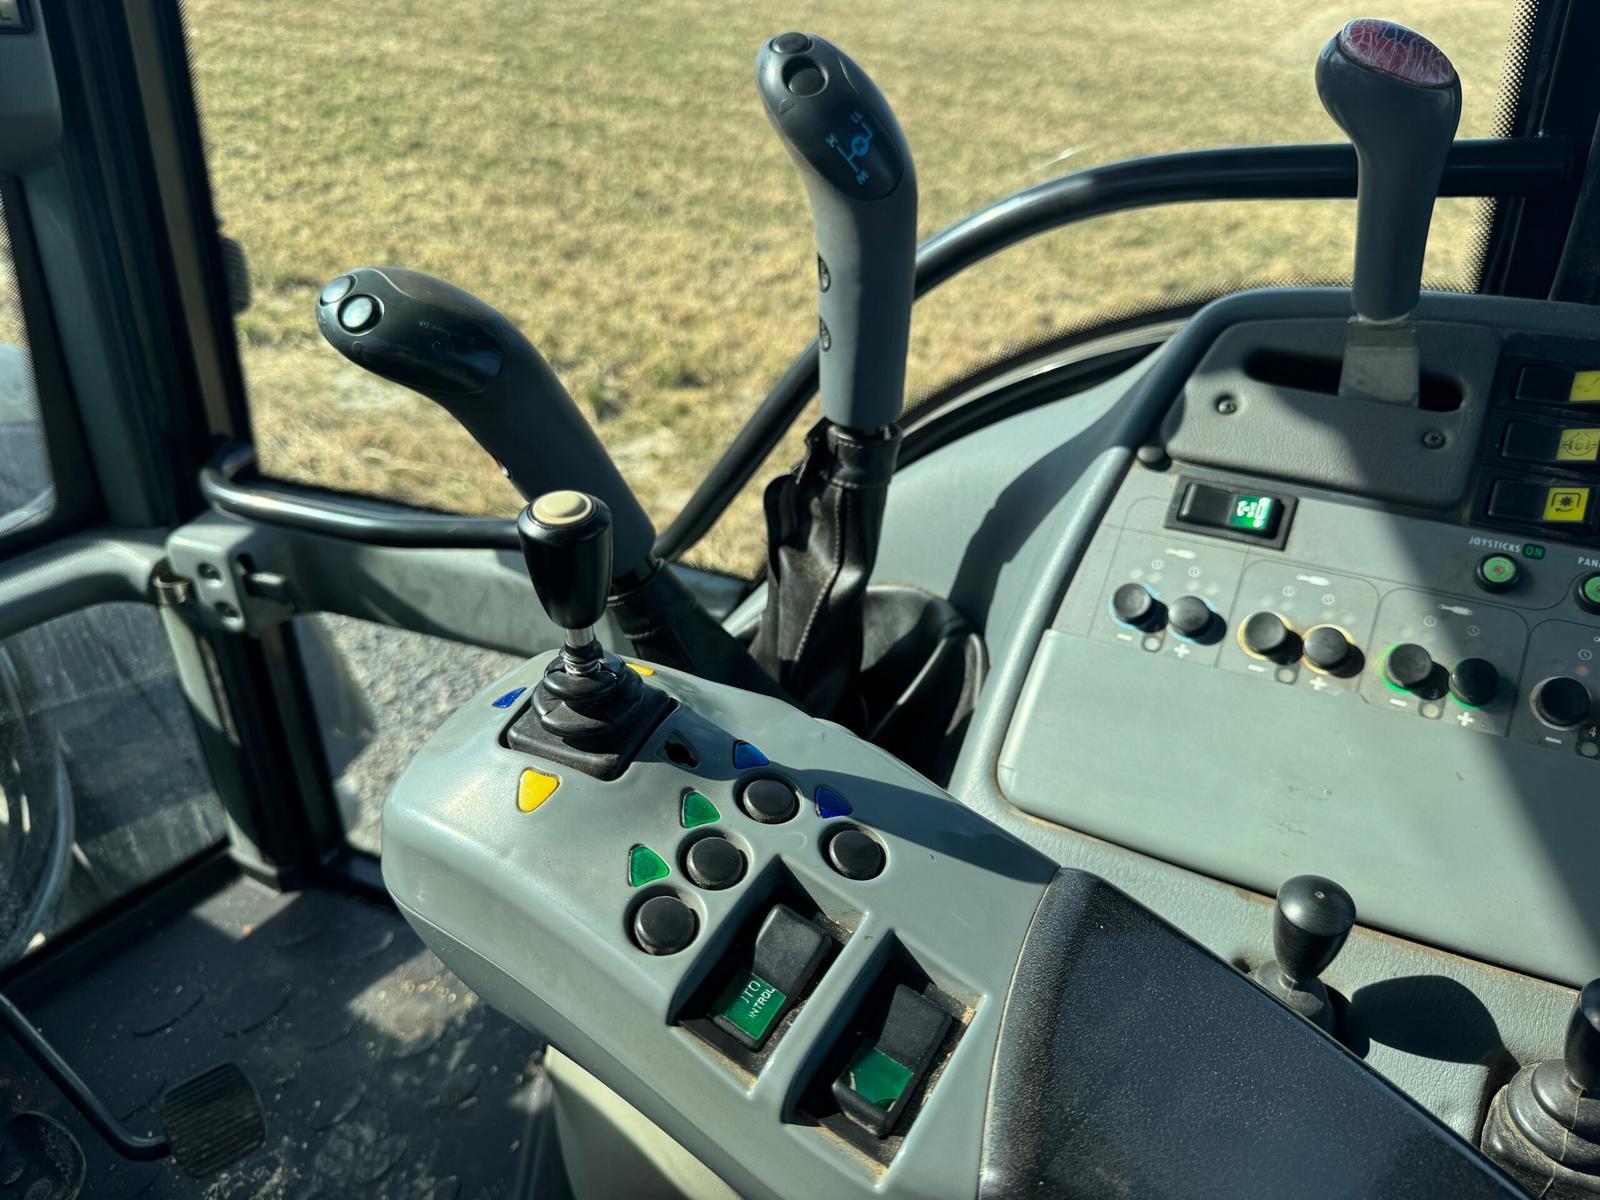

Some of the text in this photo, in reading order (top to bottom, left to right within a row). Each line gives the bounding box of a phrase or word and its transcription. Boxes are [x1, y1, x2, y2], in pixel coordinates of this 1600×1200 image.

[1469, 537, 1544, 558] JOYSTICKS ON
[1577, 556, 1600, 569] PAN
[1588, 725, 1598, 738] 4
